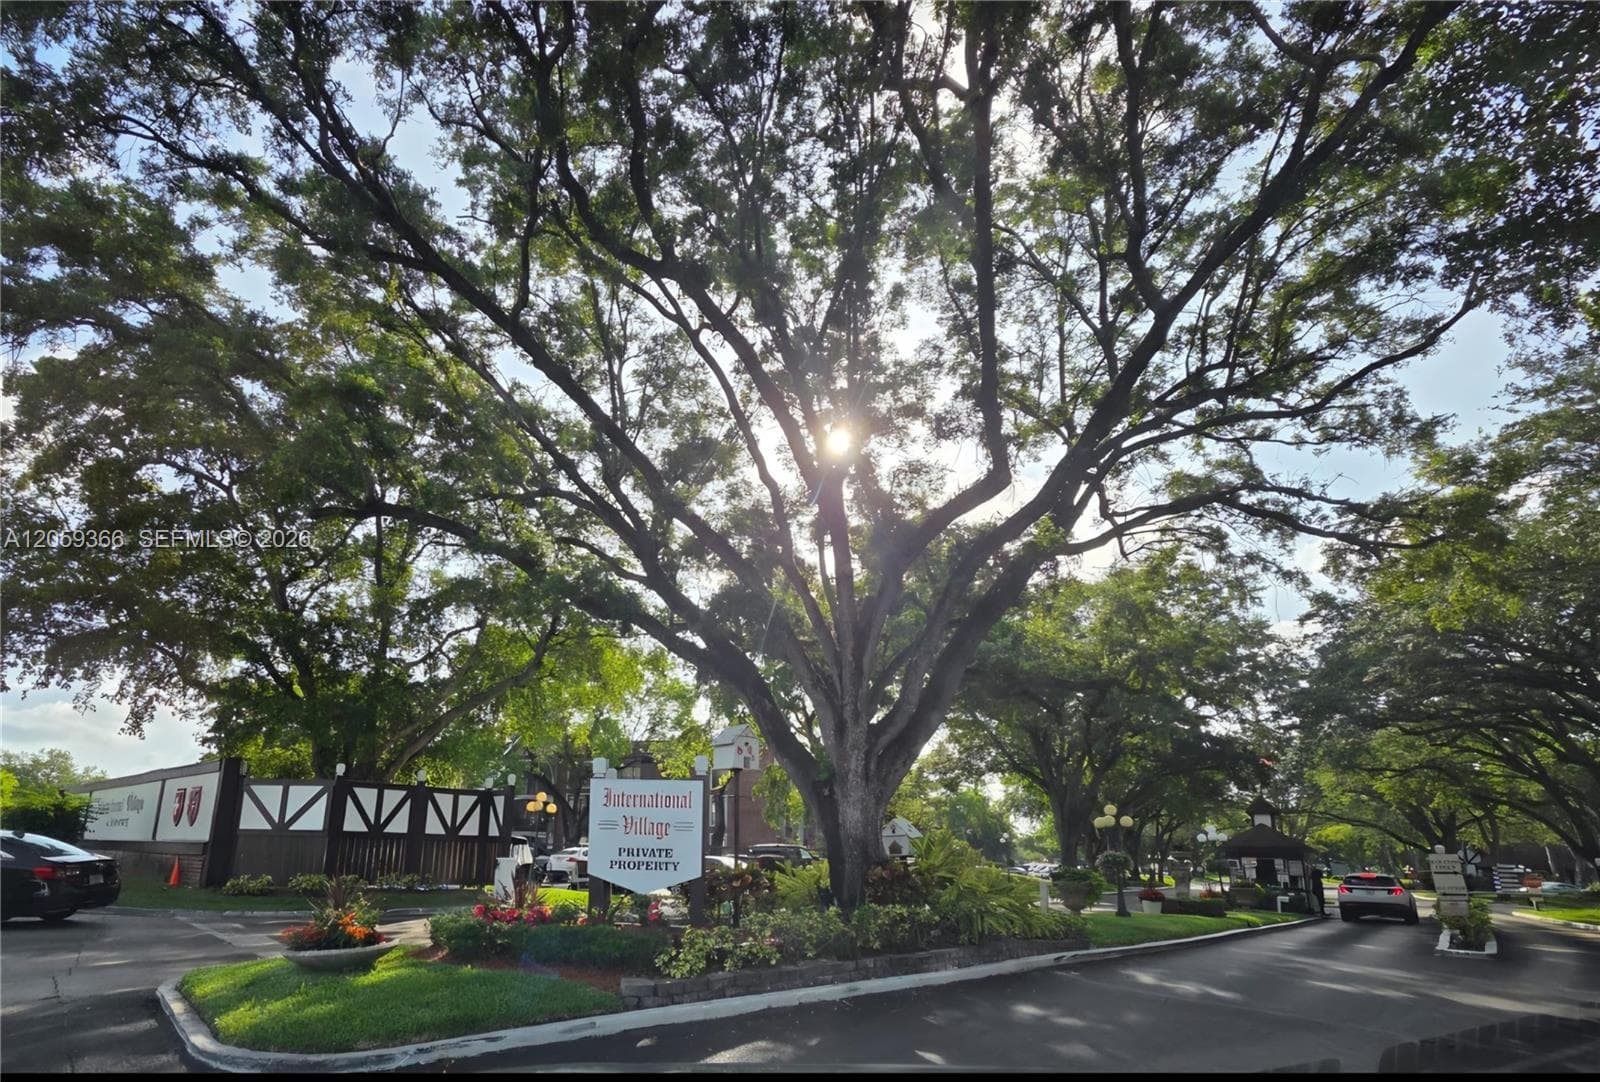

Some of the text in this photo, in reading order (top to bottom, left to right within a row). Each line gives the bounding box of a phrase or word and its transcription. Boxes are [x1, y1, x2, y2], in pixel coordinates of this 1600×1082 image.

[603, 787, 692, 808] International
[623, 815, 671, 839] Village
[618, 847, 673, 858] PRIVATE
[609, 860, 680, 871] PROPERTY
